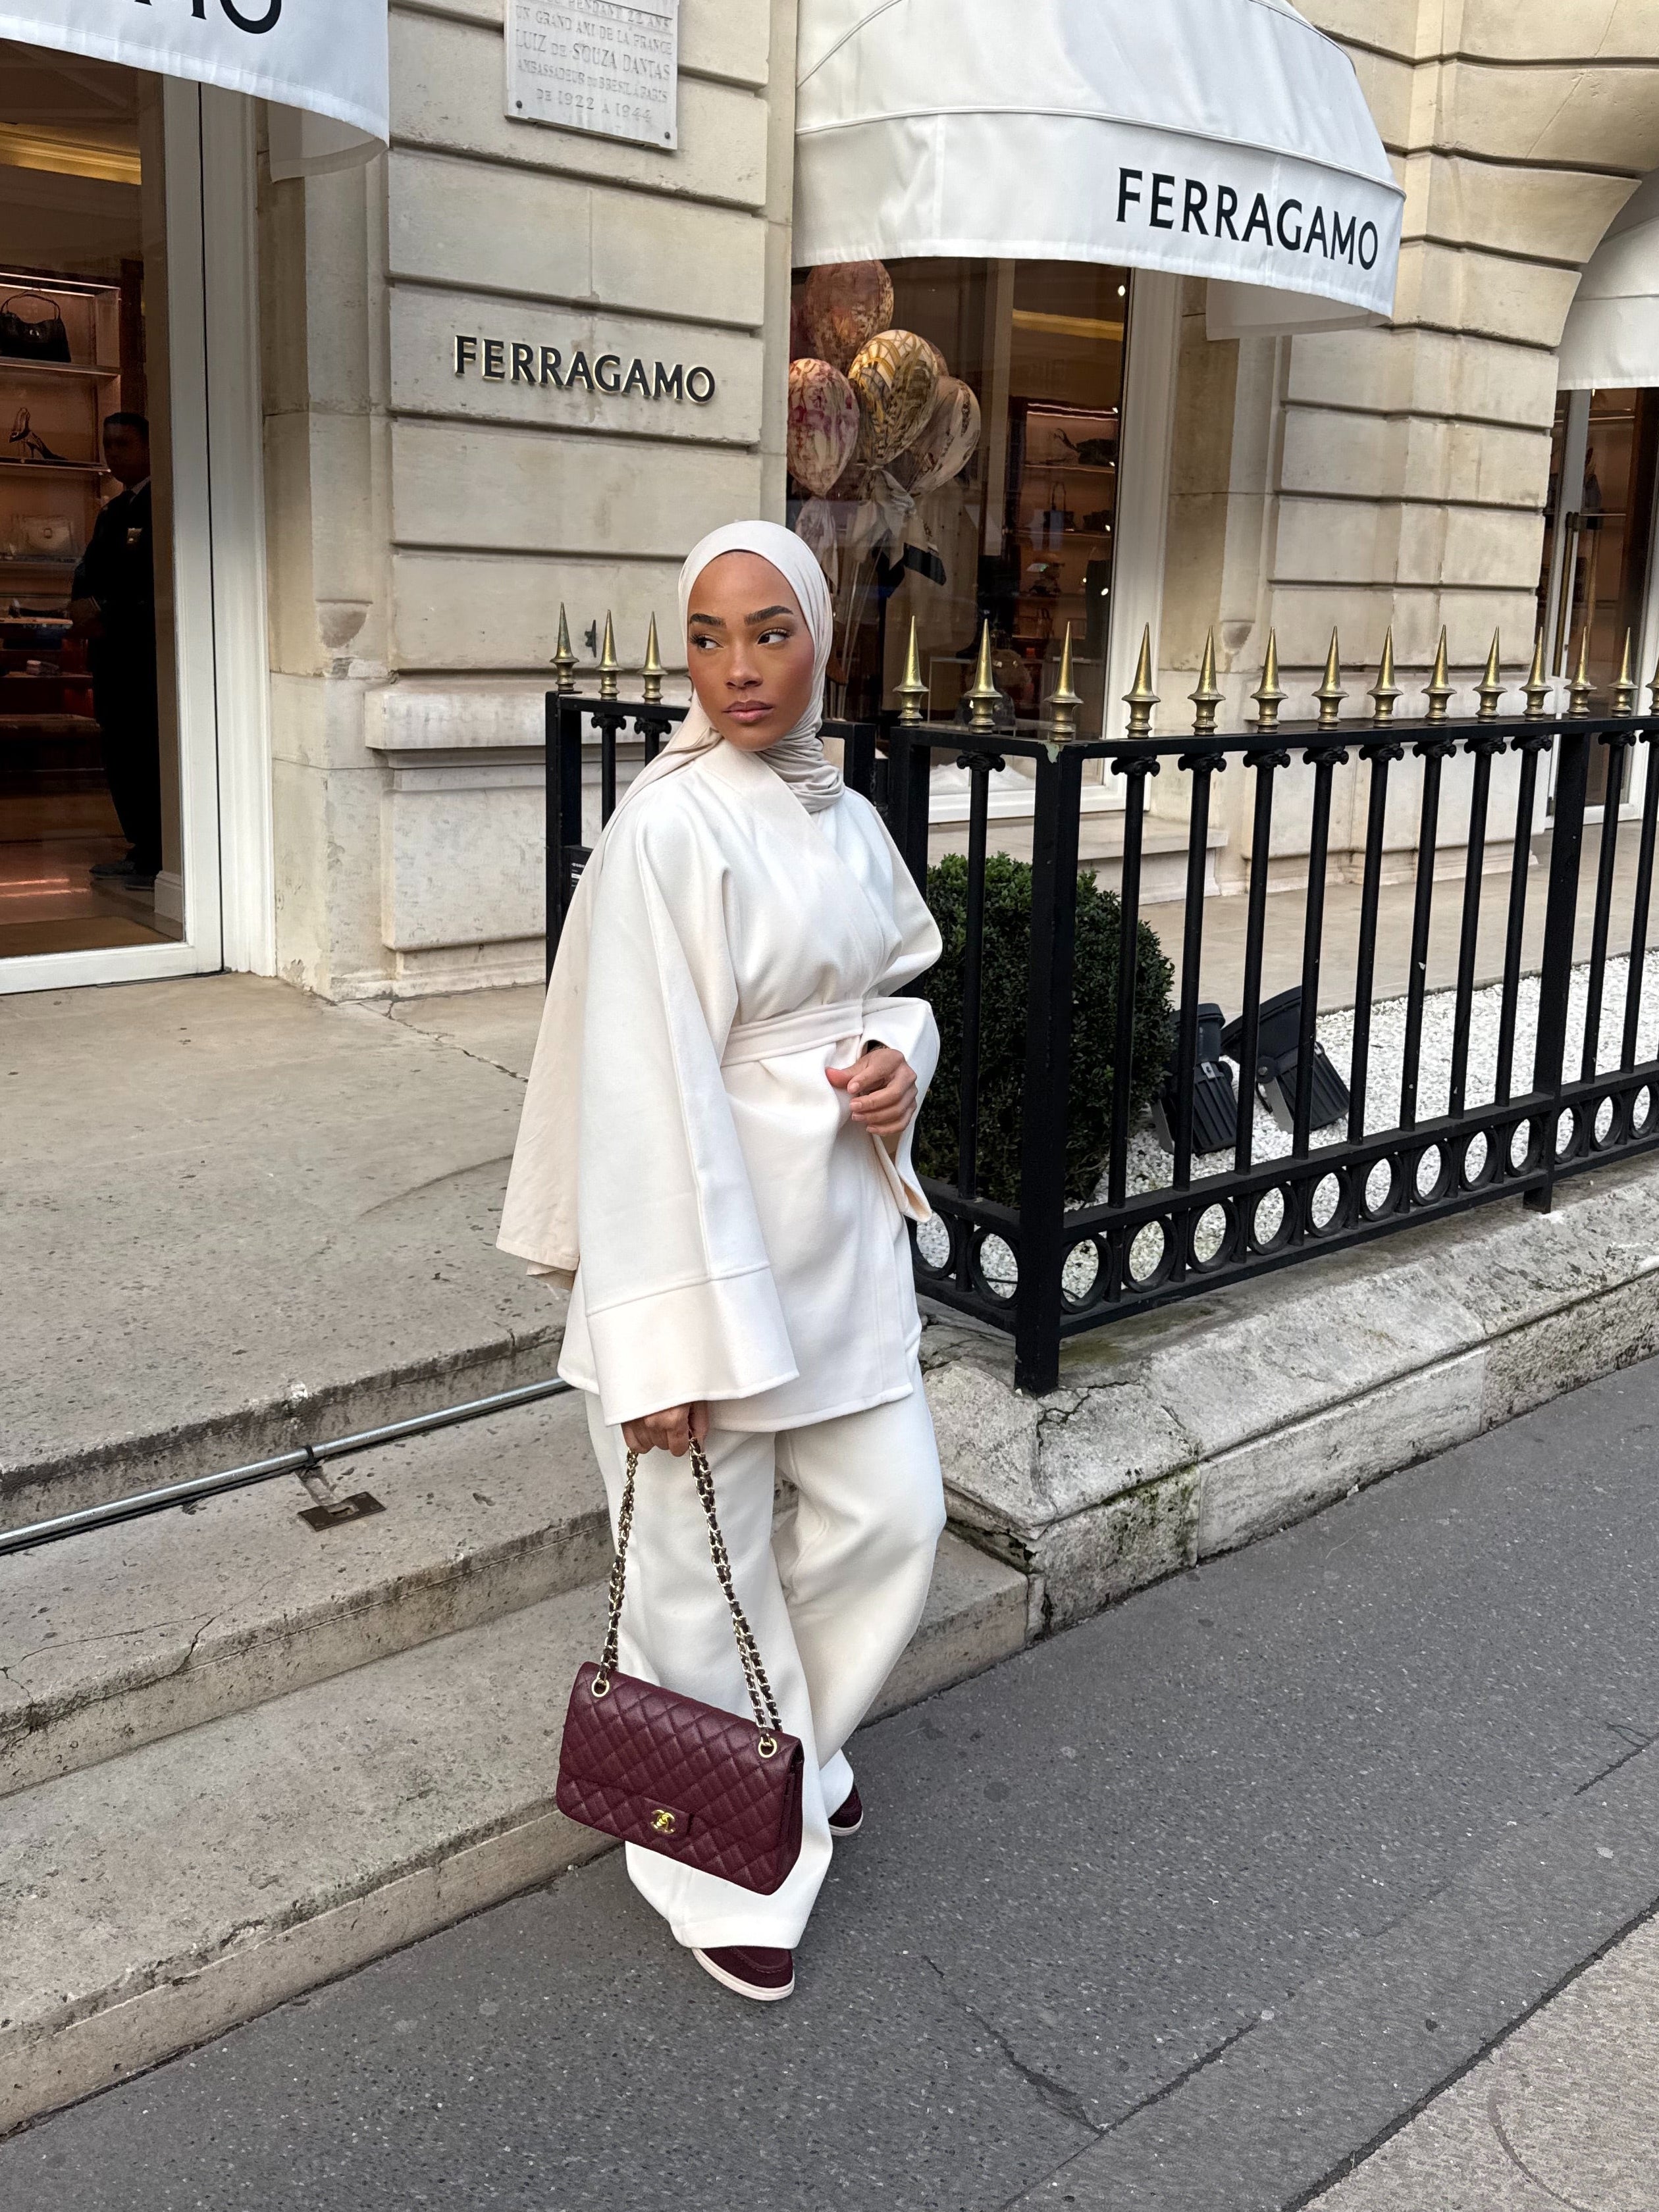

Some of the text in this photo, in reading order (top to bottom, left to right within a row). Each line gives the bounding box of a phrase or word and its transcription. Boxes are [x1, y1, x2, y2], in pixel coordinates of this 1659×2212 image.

[536, 11, 572, 30] GRAND
[599, 26, 614, 40] DE
[618, 30, 630, 45] LA
[633, 34, 672, 55] FRANCE
[627, 10, 643, 24] 22
[515, 29, 671, 80] LUIZ DE SOUZA DANTAS
[517, 59, 585, 84] AMBASSADEUR
[537, 88, 552, 101] DE
[558, 90, 594, 110] 1922
[616, 103, 652, 122] 1944
[1116, 167, 1378, 270] FERRAGAMO
[454, 335, 716, 403] FERRAGAMO
